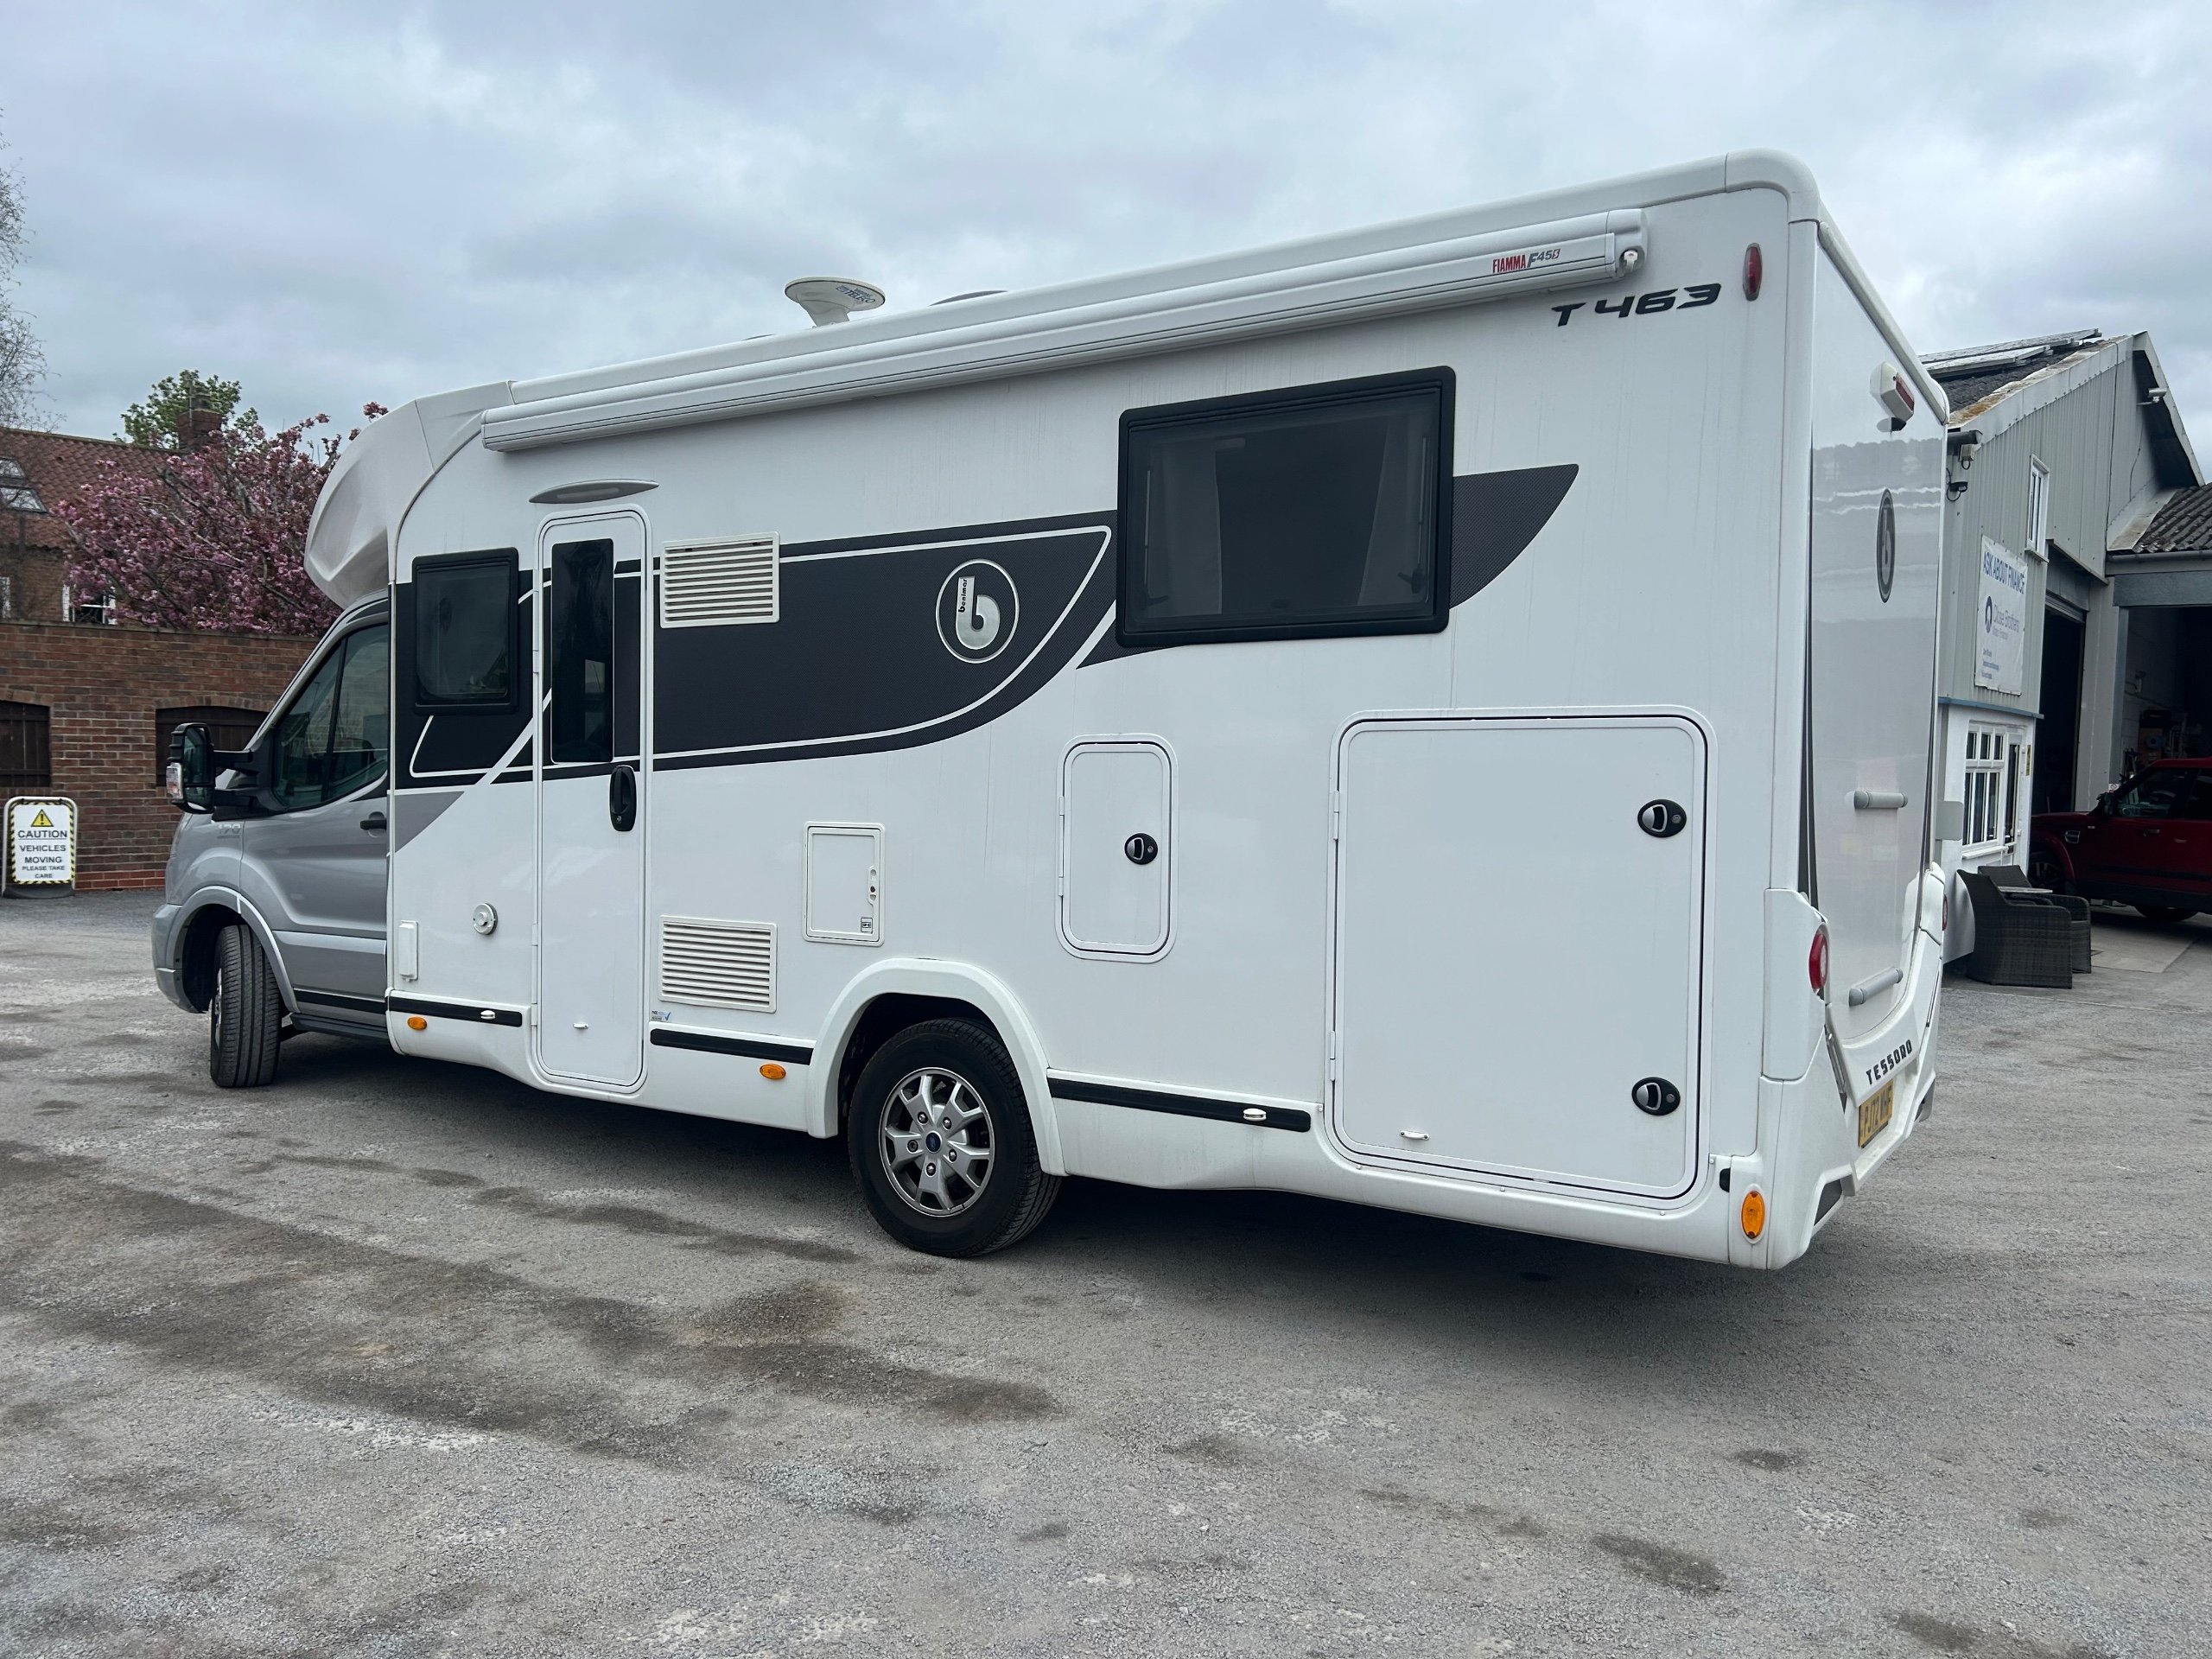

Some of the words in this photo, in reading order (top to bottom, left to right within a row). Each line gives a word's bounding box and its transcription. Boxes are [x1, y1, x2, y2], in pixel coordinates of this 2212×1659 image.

[1493, 255, 1526, 274] FIAMMA
[1983, 552, 1993, 577] ASK
[1993, 557, 2008, 585] ABOUT
[2008, 565, 2024, 594] FINANCE
[958, 579, 968, 613] benimar
[17, 830, 67, 838] CAUTION
[1866, 1039, 1913, 1085] TESSORO
